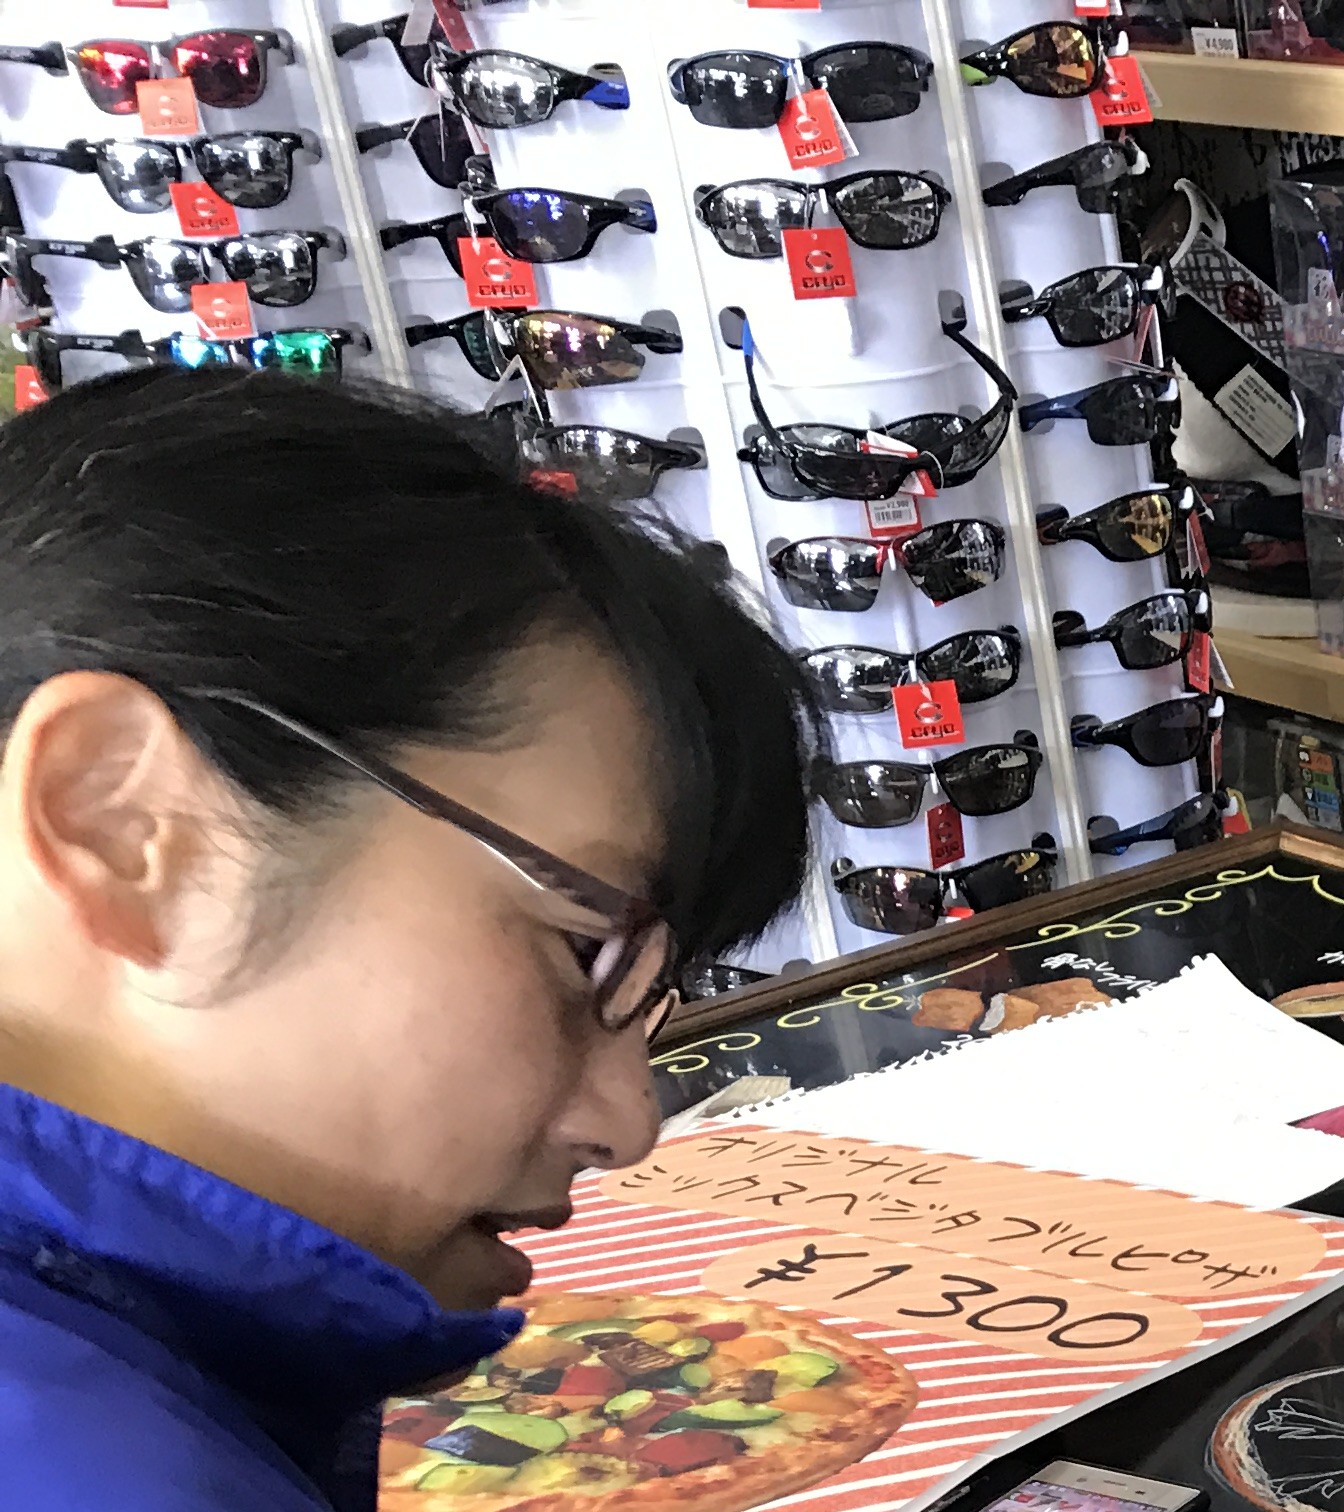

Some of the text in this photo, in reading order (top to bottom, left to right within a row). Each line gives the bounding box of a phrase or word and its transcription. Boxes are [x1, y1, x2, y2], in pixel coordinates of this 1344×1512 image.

[1101, 98, 1142, 118] cryo
[794, 139, 834, 158] cryo
[478, 284, 526, 299] cryo
[802, 276, 846, 291] cryo
[909, 722, 957, 738] cryo
[698, 1136, 948, 1185] オリジナル
[620, 1165, 1280, 1289] ミックスベジタブルピザ
[744, 1243, 1150, 1349] ¥1300
